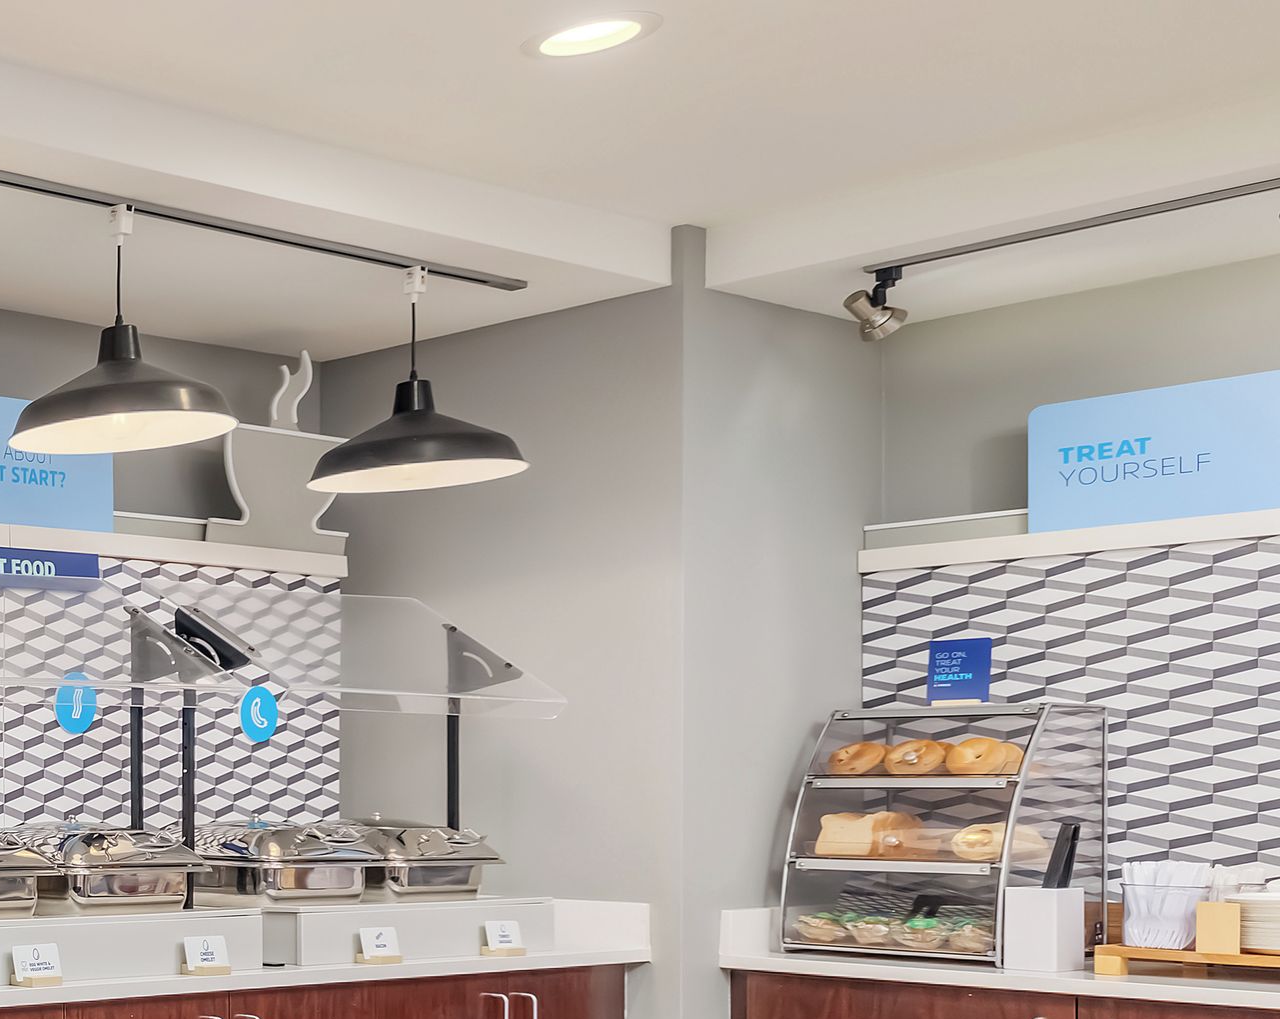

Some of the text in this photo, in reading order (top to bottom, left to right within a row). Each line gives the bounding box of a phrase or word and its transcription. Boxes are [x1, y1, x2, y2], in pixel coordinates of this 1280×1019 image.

[1058, 436, 1152, 465] TREAT
[1059, 451, 1212, 488] YOURSELF
[11, 466, 66, 488] START?
[11, 558, 56, 577] FOOD
[935, 652, 950, 660] GO
[935, 658, 963, 667] TREAT
[935, 666, 961, 674] YOUR
[933, 673, 973, 682] HEALTH
